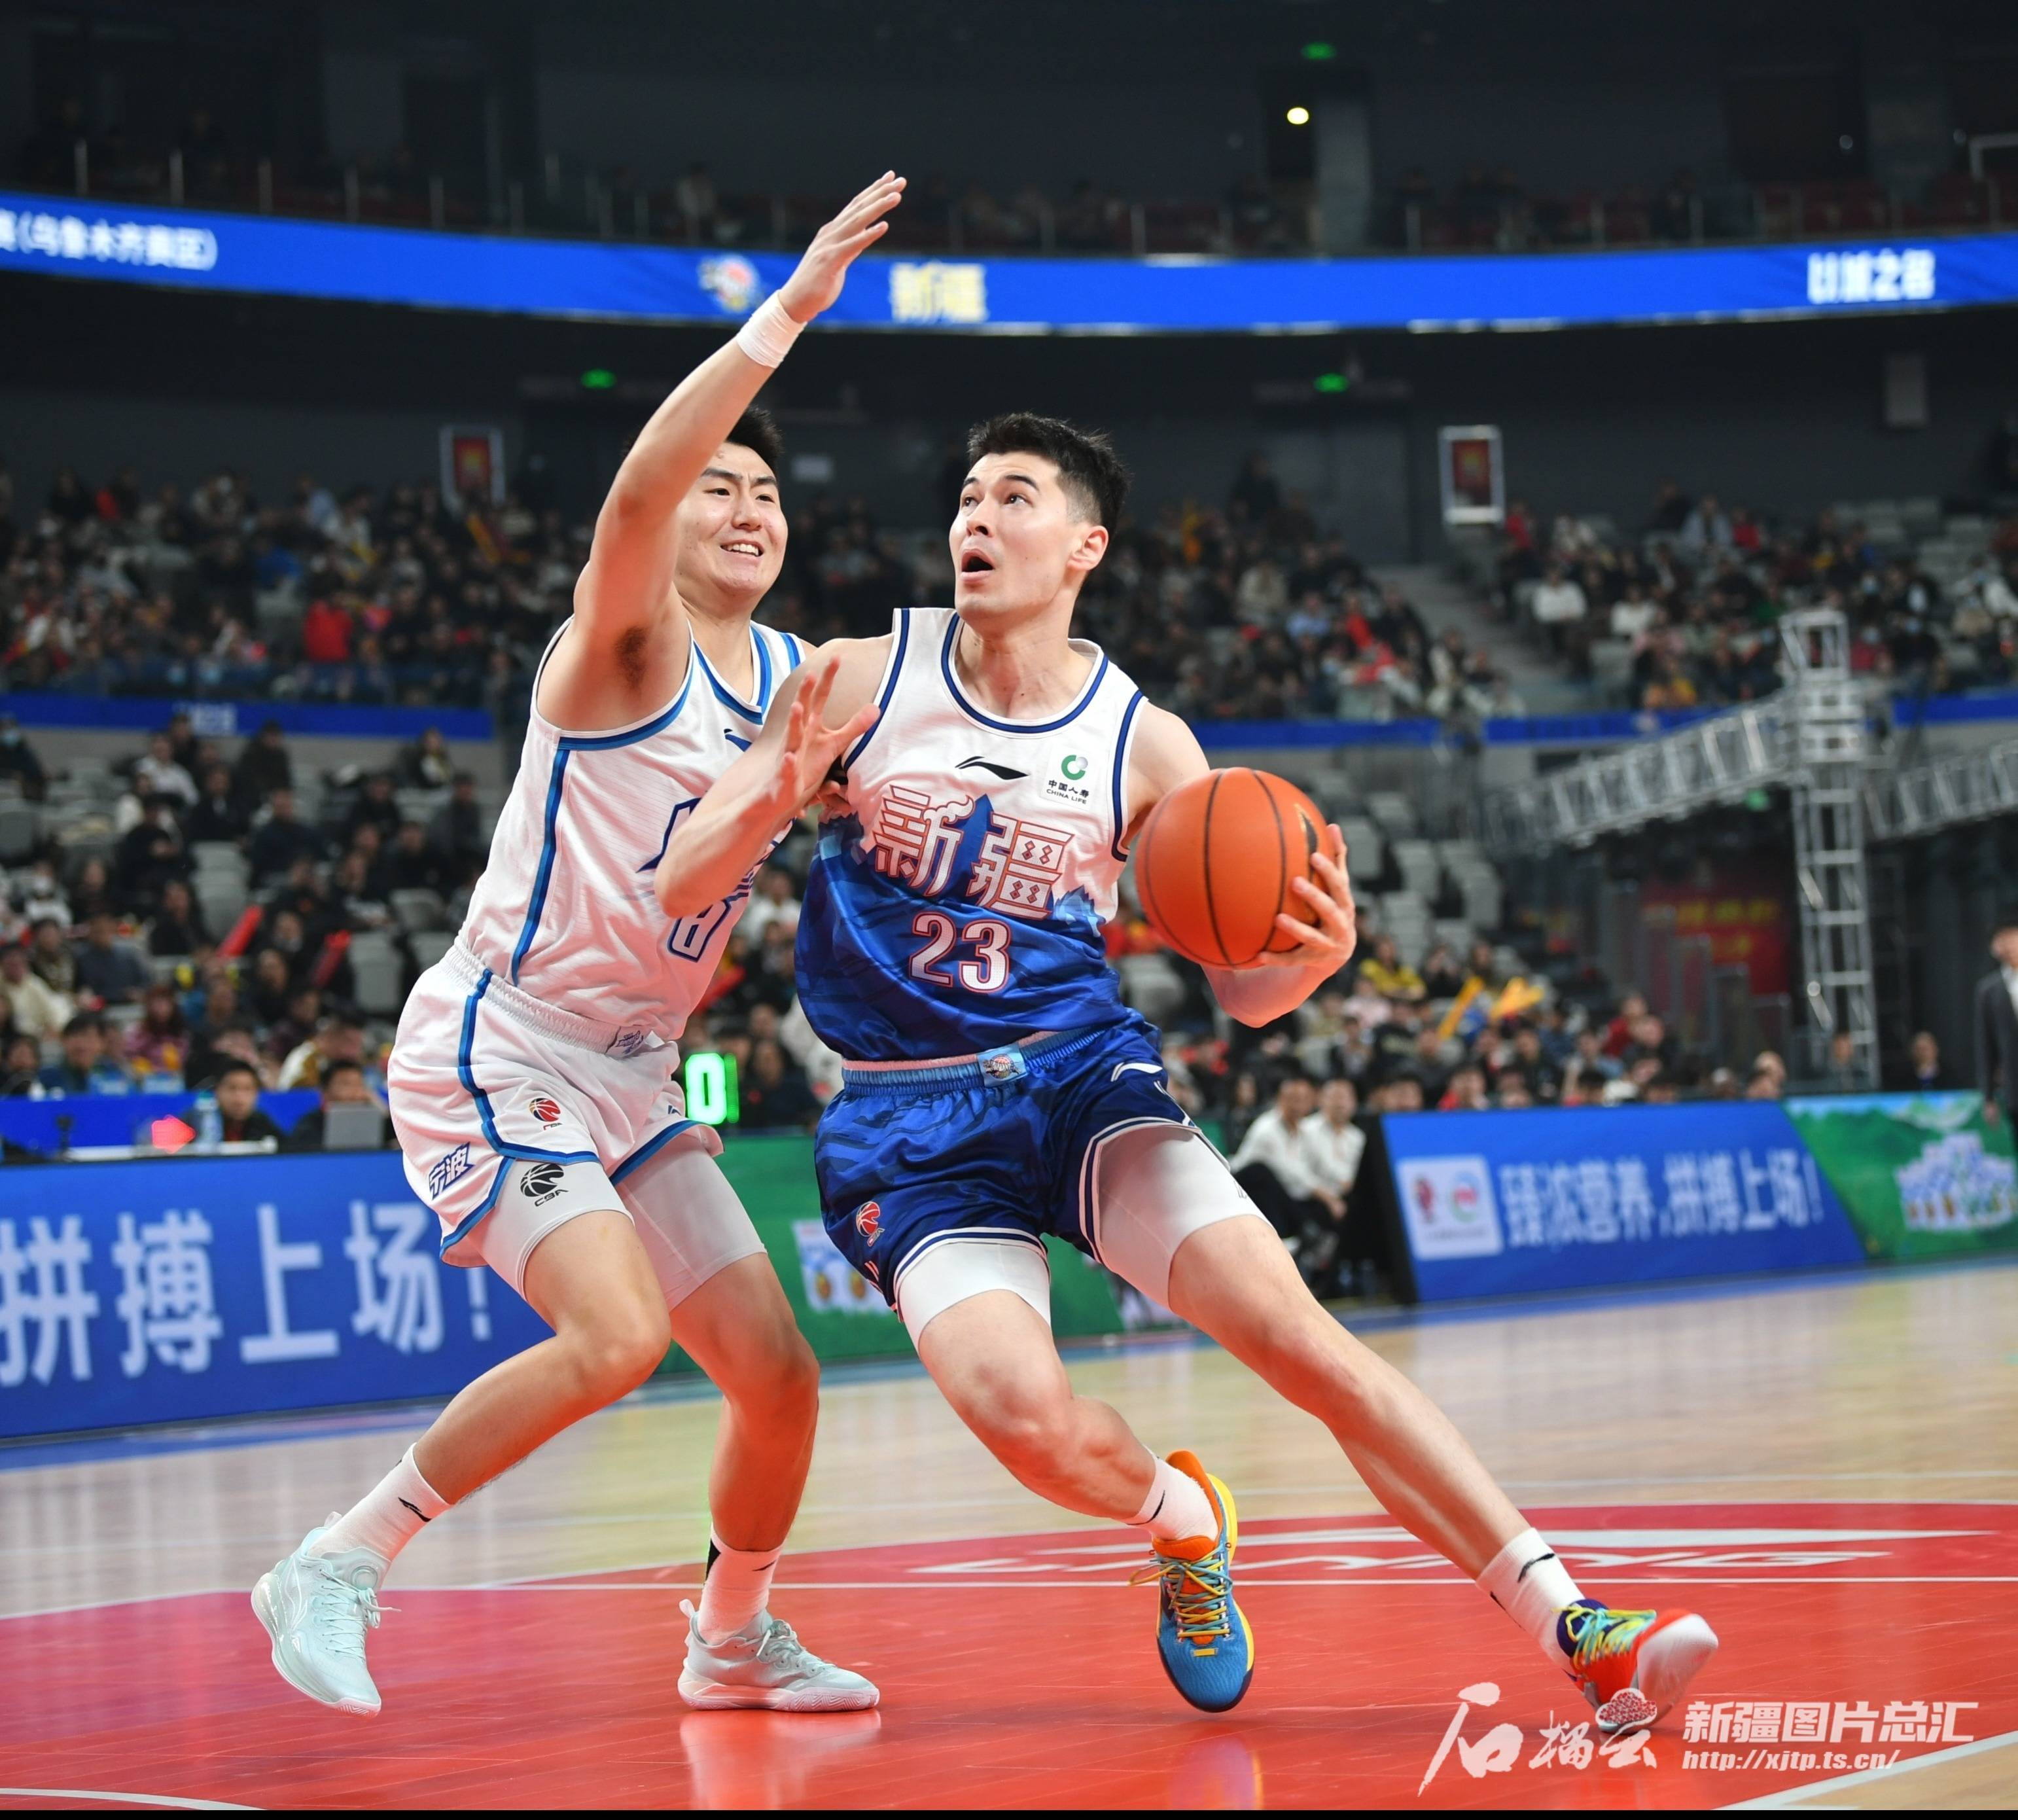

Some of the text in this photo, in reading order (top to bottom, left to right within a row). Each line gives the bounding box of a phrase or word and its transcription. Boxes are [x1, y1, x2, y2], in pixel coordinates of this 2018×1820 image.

[1046, 789, 1087, 804] CHINA LIFE
[1048, 779, 1089, 798] 中国人寿
[872, 784, 1075, 921] 新疆
[909, 912, 1011, 993] 23
[685, 1053, 728, 1124] 0
[534, 1189, 569, 1207] CBA
